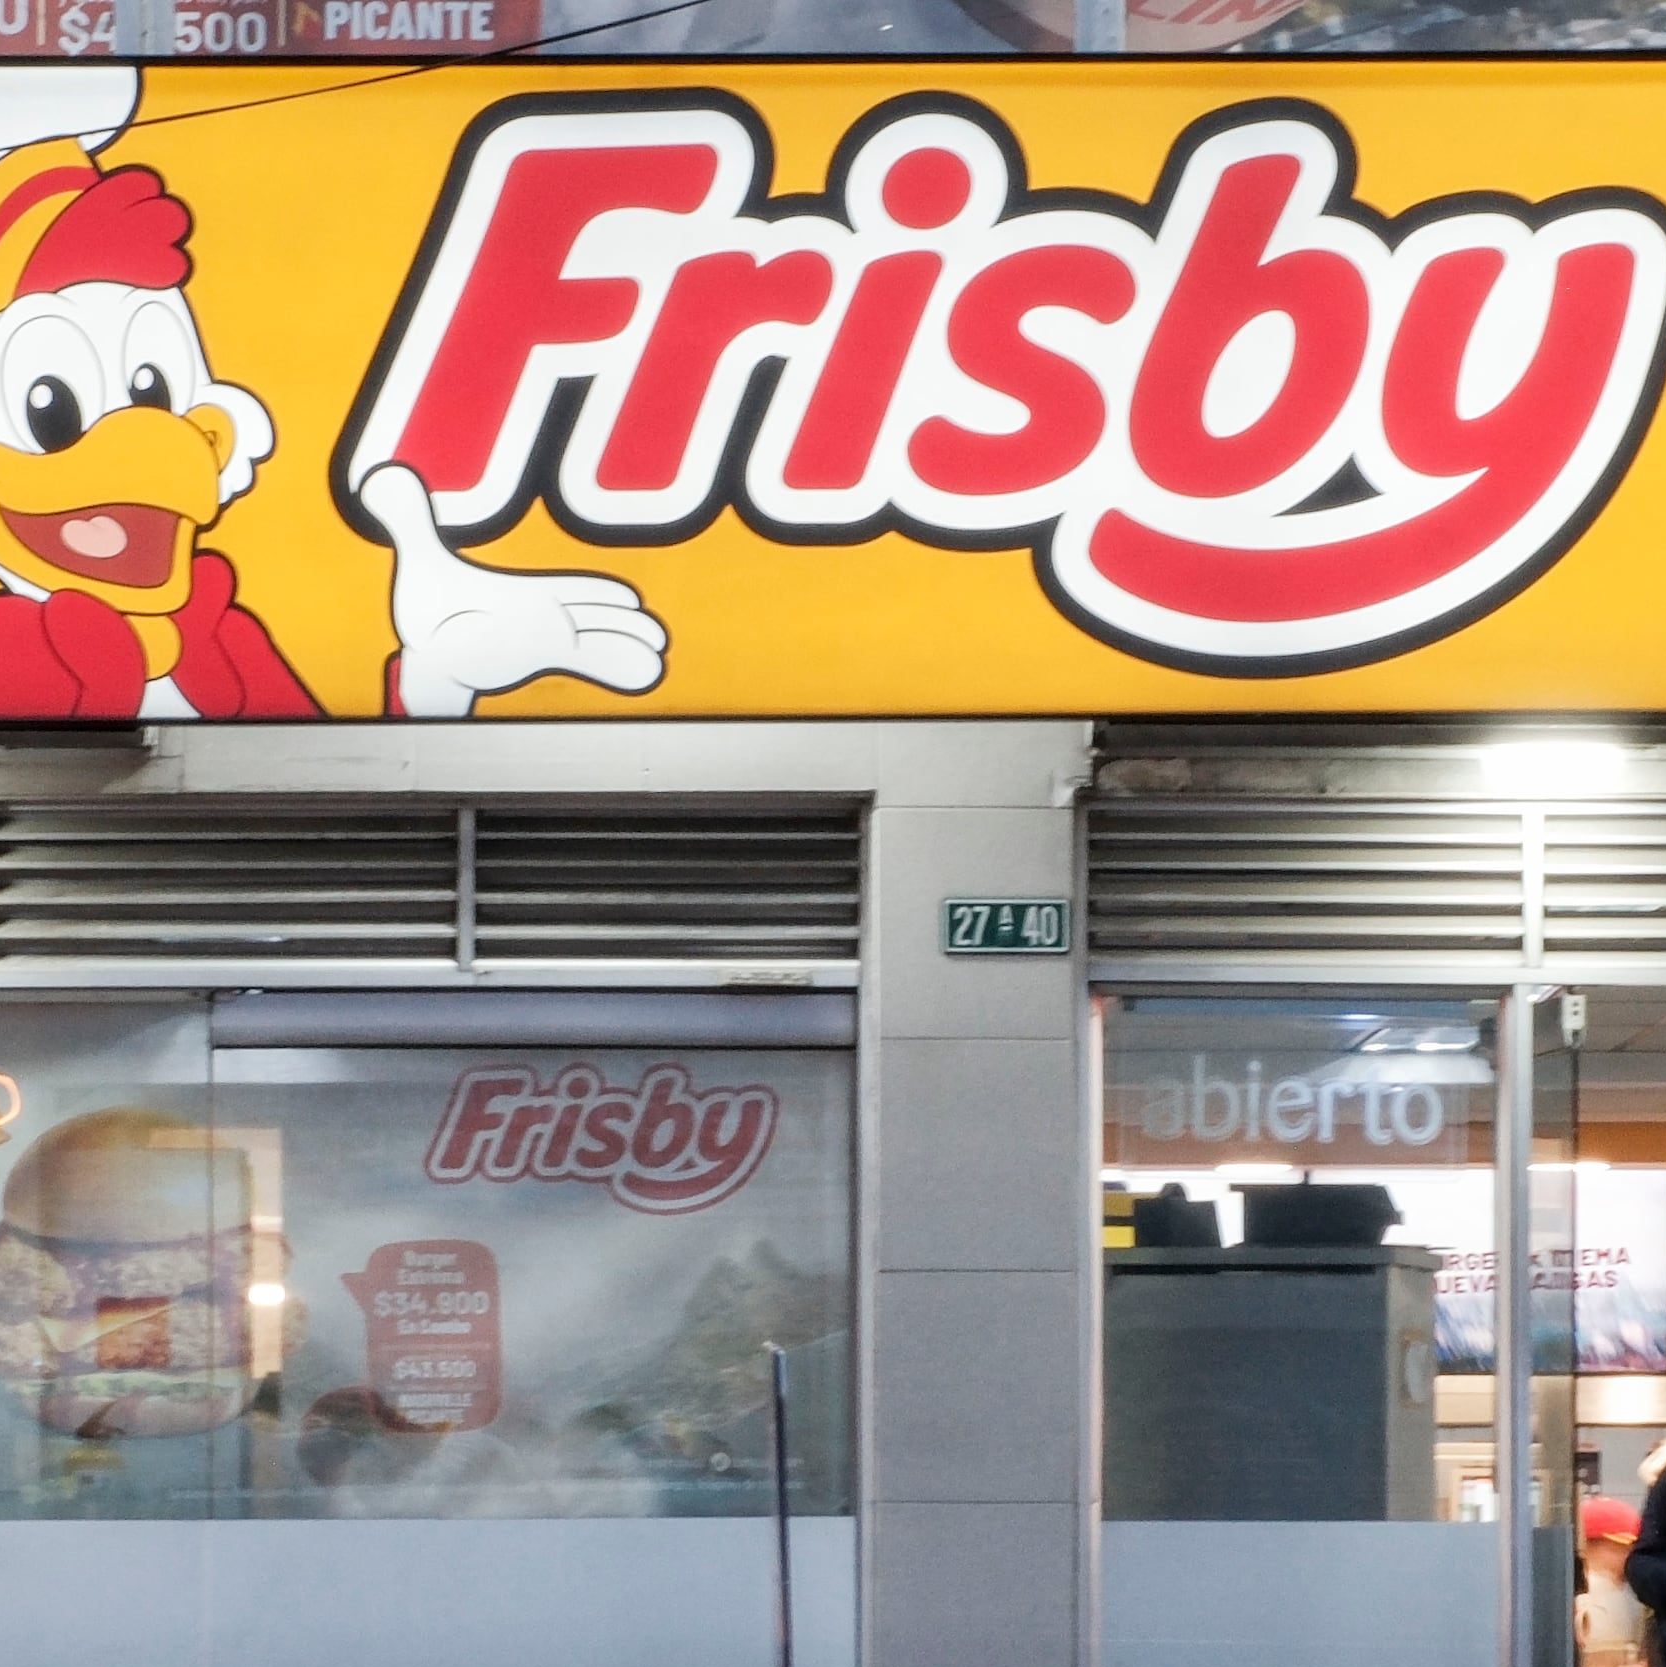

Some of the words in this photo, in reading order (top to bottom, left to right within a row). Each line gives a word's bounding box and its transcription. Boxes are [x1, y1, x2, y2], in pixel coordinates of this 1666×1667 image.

[323, 1, 495, 42] PICANTE
[430, 1067, 774, 1208] Frisby
[1140, 1055, 1445, 1146] abierto
